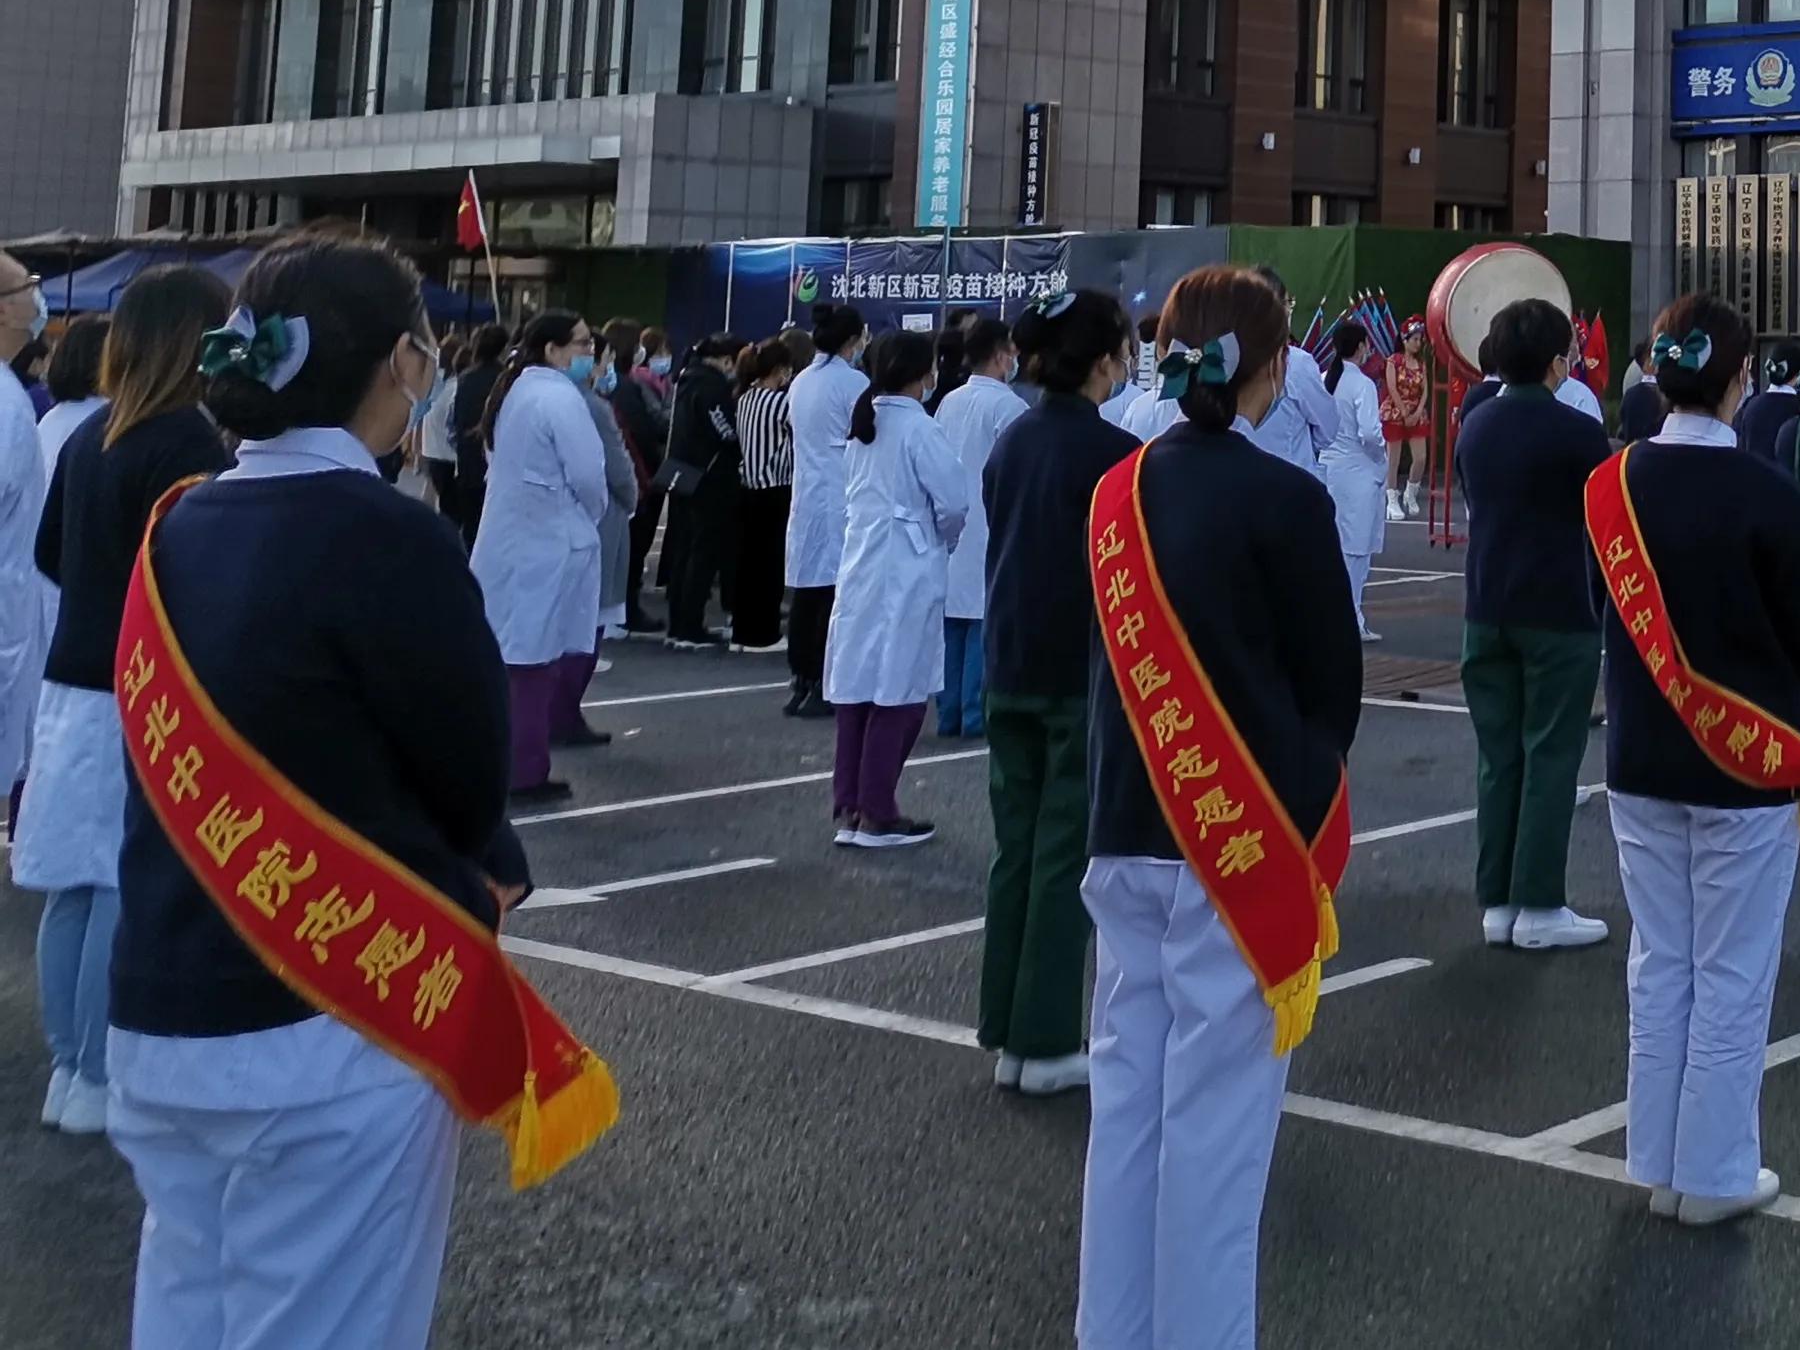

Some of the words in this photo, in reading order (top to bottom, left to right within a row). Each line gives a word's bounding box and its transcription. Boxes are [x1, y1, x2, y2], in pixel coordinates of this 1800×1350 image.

[1687, 66, 1737, 97] 警务
[1097, 520, 1266, 878] 辽北中医院志愿者
[1606, 534, 1784, 778] 辽北中医院志愿者
[117, 638, 464, 1031] 辽北中医院志愿者
